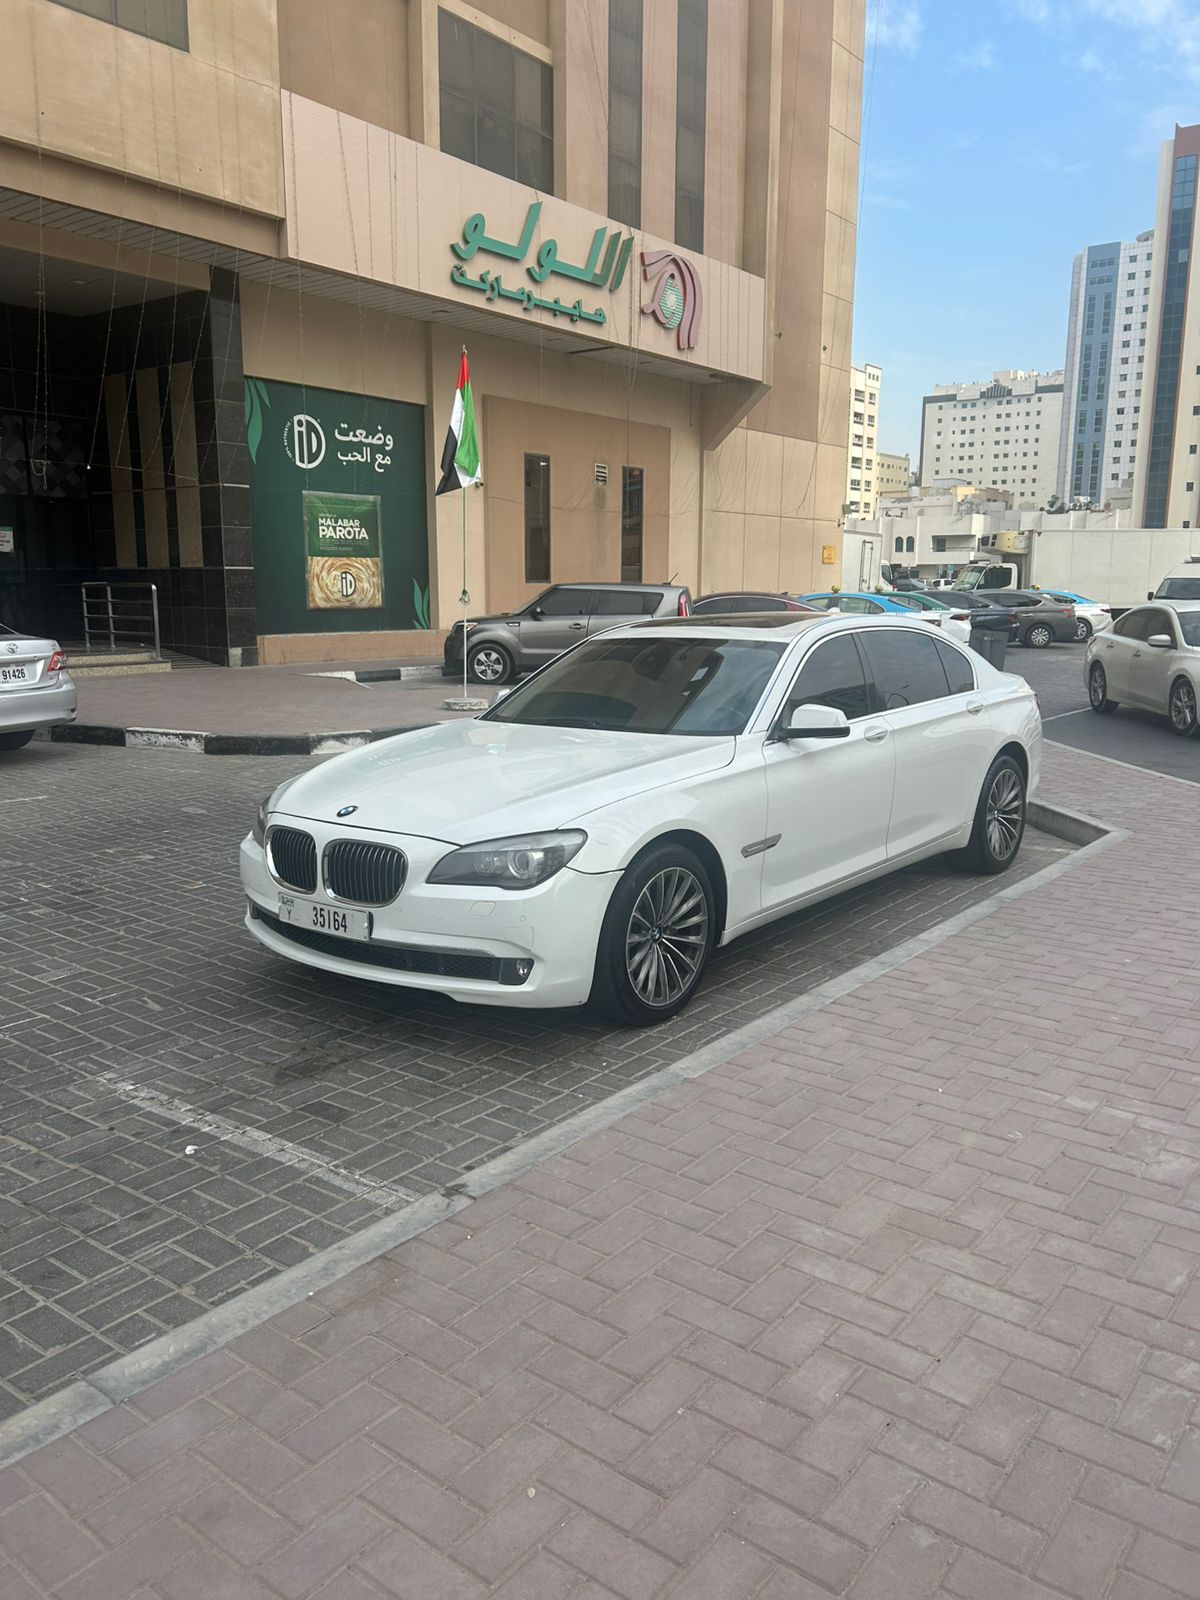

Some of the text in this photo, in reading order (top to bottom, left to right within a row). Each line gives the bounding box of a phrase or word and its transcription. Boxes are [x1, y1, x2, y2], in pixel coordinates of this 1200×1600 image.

[450, 200, 635, 293] اللولو
[334, 422, 394, 451] وضعت
[337, 446, 392, 473] مع الحب
[318, 517, 360, 527] MALABAR
[318, 526, 369, 540] PAROTA
[2, 668, 26, 680] 91426
[312, 906, 347, 933] 35164
